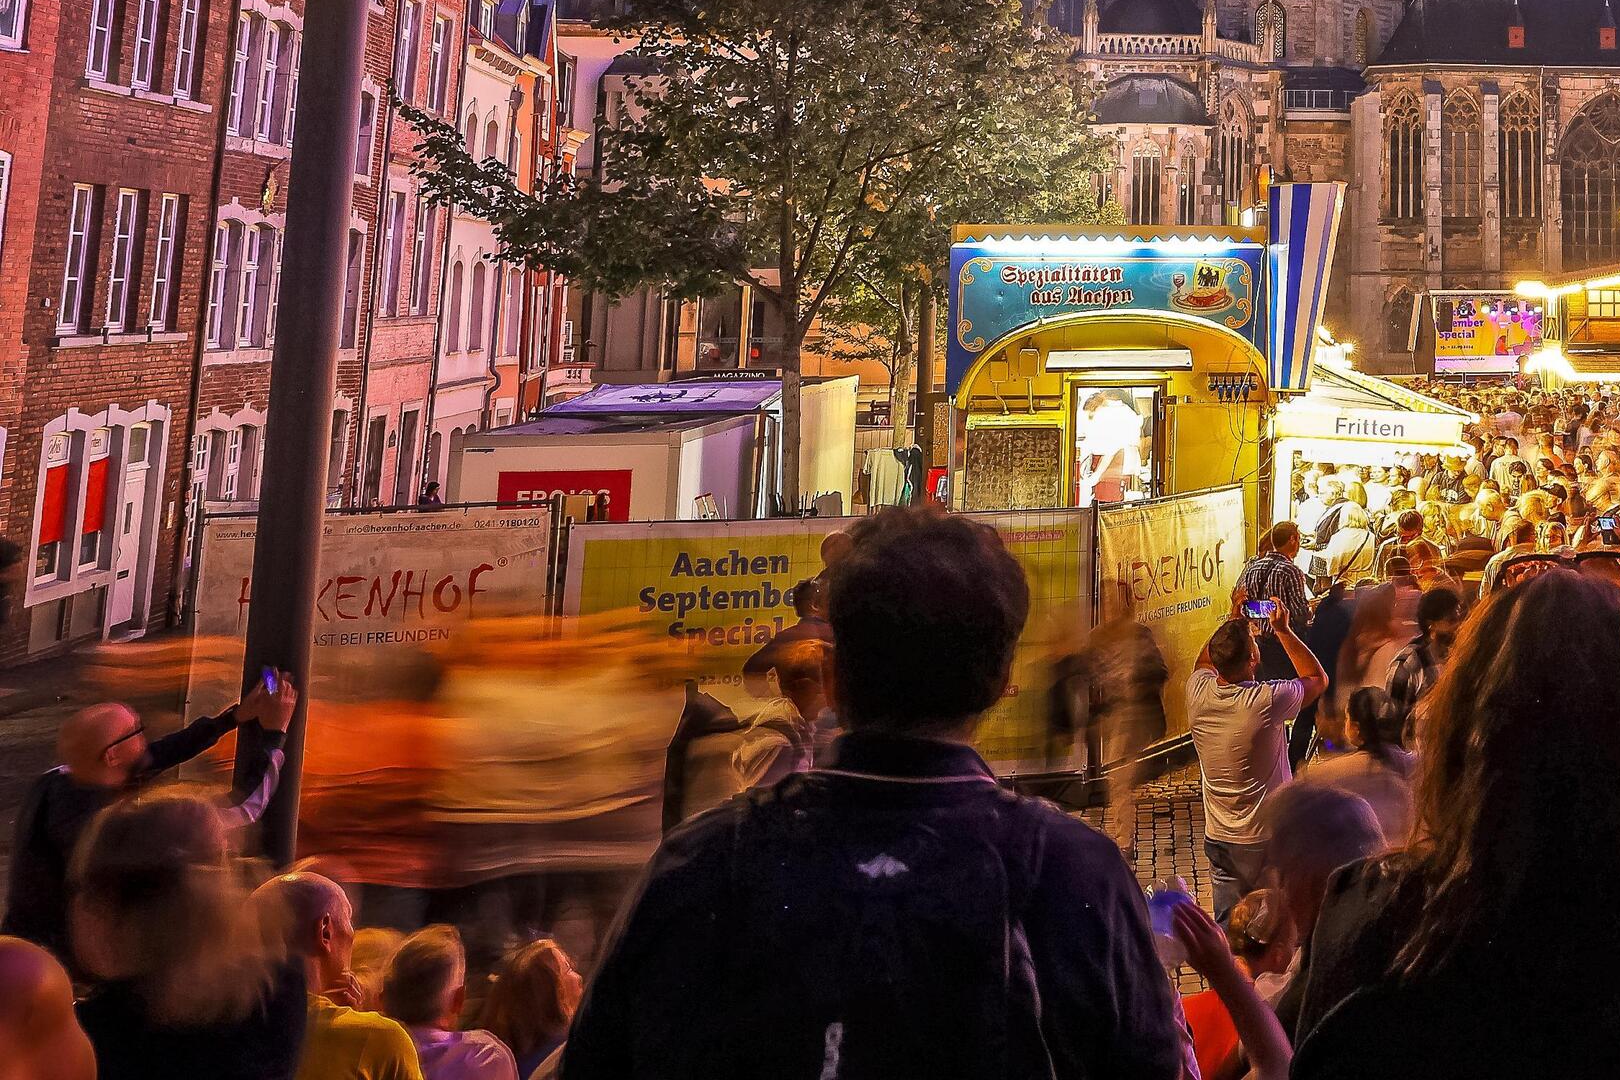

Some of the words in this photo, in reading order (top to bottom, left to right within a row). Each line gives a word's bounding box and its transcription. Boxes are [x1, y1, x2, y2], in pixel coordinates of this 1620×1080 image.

[1001, 264, 1123, 289] Spezialitäten
[1031, 288, 1063, 305] aus
[1066, 286, 1134, 309] Aachen
[1439, 329, 1475, 341] Special
[1335, 417, 1405, 437] Fritten
[670, 549, 790, 577] Aachen
[1116, 538, 1226, 608] HEXENHOF
[639, 581, 796, 619] Septembe
[1148, 607, 1165, 622] GAST
[1176, 596, 1212, 613] FREUNDEN
[340, 633, 362, 646] BEI
[366, 628, 450, 644] FREUNDEN
